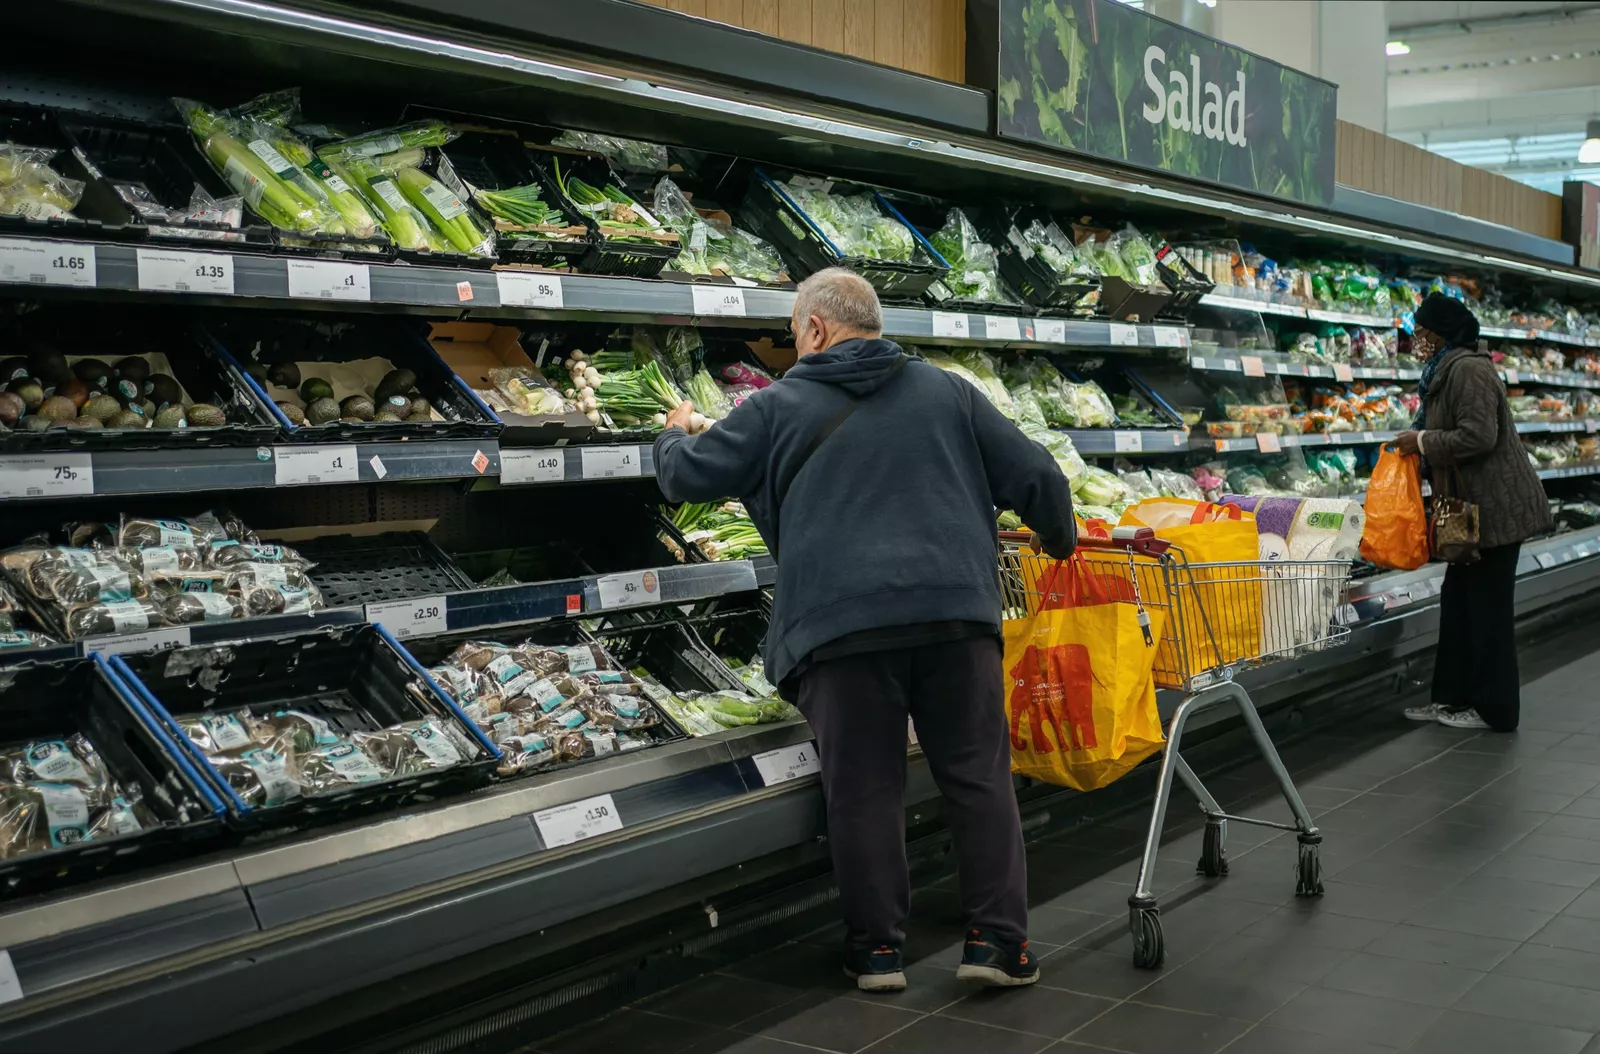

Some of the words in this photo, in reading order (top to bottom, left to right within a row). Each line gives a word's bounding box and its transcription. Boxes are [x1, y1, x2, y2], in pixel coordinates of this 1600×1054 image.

[1143, 45, 1247, 148] Salad
[53, 256, 84, 269] £1.65
[196, 266, 224, 277] £1.35
[345, 275, 354, 286] £1
[539, 285, 553, 296] 95p
[724, 296, 739, 304] £1.04
[332, 457, 343, 468] £1
[538, 459, 558, 468] £1.40
[623, 455, 630, 464] £1
[54, 466, 77, 480] 75p
[625, 583, 637, 592] 43p
[415, 607, 438, 619] £2.50
[798, 752, 807, 762] £1
[585, 806, 608, 820] £1.50
